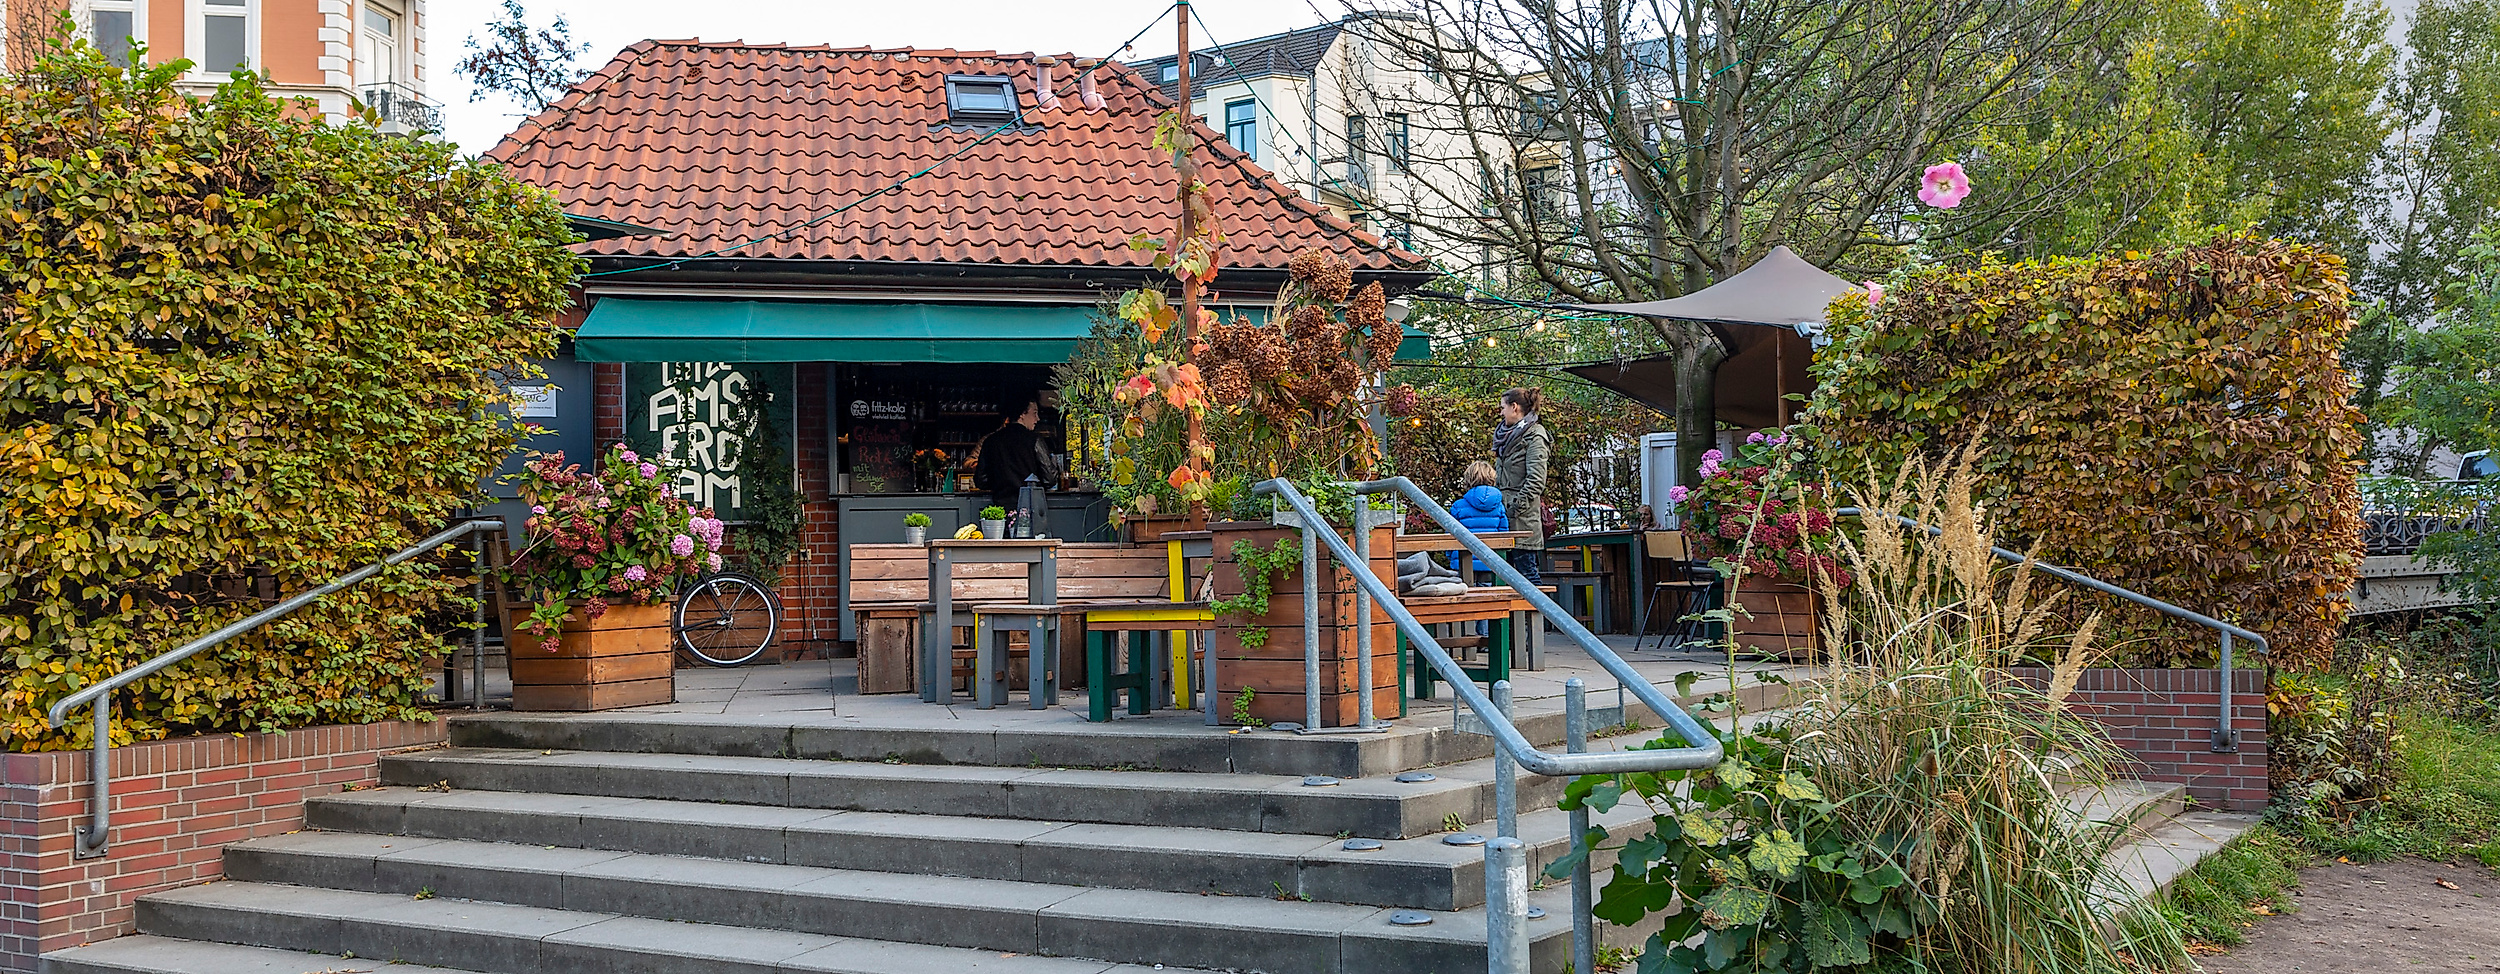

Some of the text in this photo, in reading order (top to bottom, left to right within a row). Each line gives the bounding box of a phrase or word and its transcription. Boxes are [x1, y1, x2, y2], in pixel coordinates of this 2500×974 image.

[872, 400, 906, 413] fritz-kola
[671, 469, 740, 509] AM
[867, 482, 886, 493] 5€
